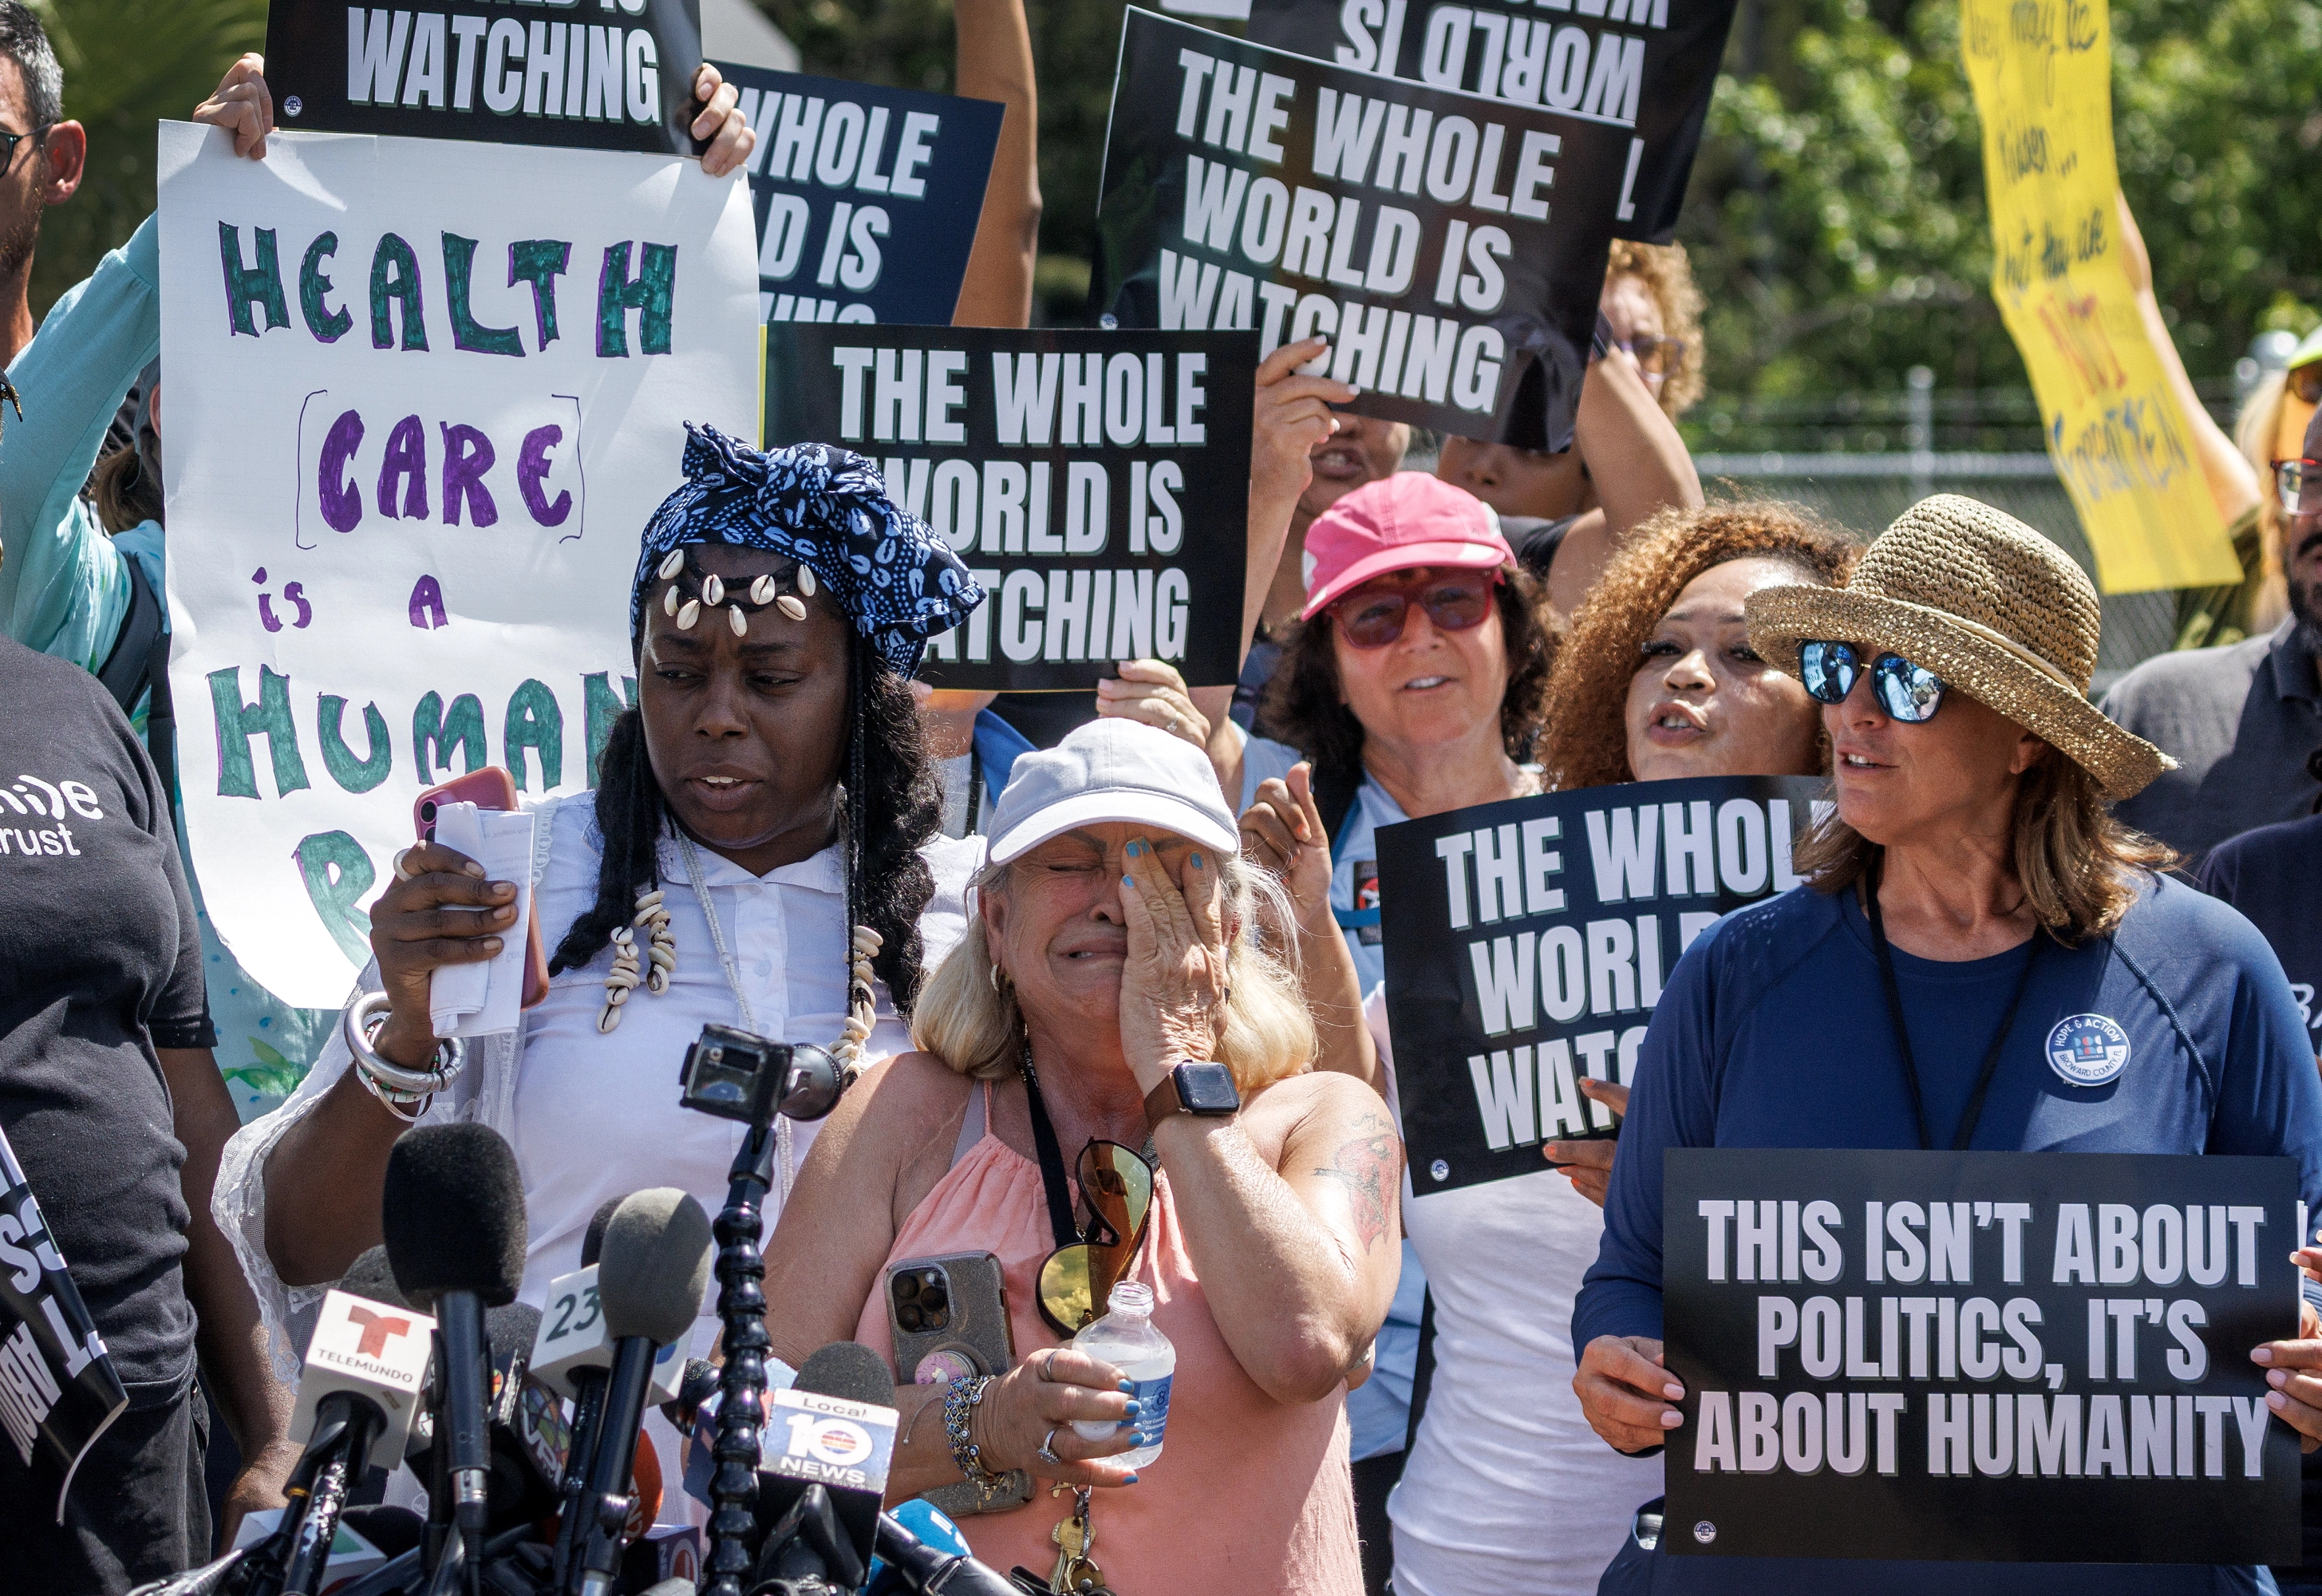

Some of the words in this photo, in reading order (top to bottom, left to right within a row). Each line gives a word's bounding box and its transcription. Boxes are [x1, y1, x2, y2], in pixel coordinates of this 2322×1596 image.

[347, 7, 661, 124] WATCHING
[1421, 6, 1645, 120] WORLD
[1176, 49, 1295, 162] THE
[1313, 87, 1561, 219] WHOLE
[817, 201, 890, 289] IS
[1183, 155, 1420, 295] WORLD
[1436, 219, 1511, 310] IS
[219, 220, 678, 358] HEALTH
[1159, 248, 1505, 414] WATCHING
[834, 346, 966, 444] THE
[993, 352, 1207, 447] WHOLE
[1131, 460, 1185, 555] IS
[251, 567, 312, 632] is
[923, 568, 1190, 662] TCHING
[207, 664, 638, 800] HUMAN
[0, 823, 81, 855] rust
[1436, 816, 1566, 930] THE
[1586, 799, 1835, 903] WHOL
[2055, 1024, 2074, 1046] HOPE
[2085, 1018, 2122, 1042] ACTION
[2059, 1053, 2091, 1077] BROWARD
[1698, 1199, 1843, 1283] THIS
[1865, 1201, 2032, 1284] ISN'T
[2051, 1203, 2265, 1286] ABOUT
[546, 1285, 601, 1342] 23
[1758, 1296, 2067, 1389] POLITICS,
[2087, 1298, 2207, 1381] IT'S
[318, 1349, 413, 1383] TELEMUNDO
[803, 1397, 867, 1418] Local
[780, 1456, 866, 1484] NEWS
[786, 1413, 874, 1466] 10
[1693, 1390, 1905, 1475] ABOUT
[1928, 1393, 2272, 1477] HUMANITY
